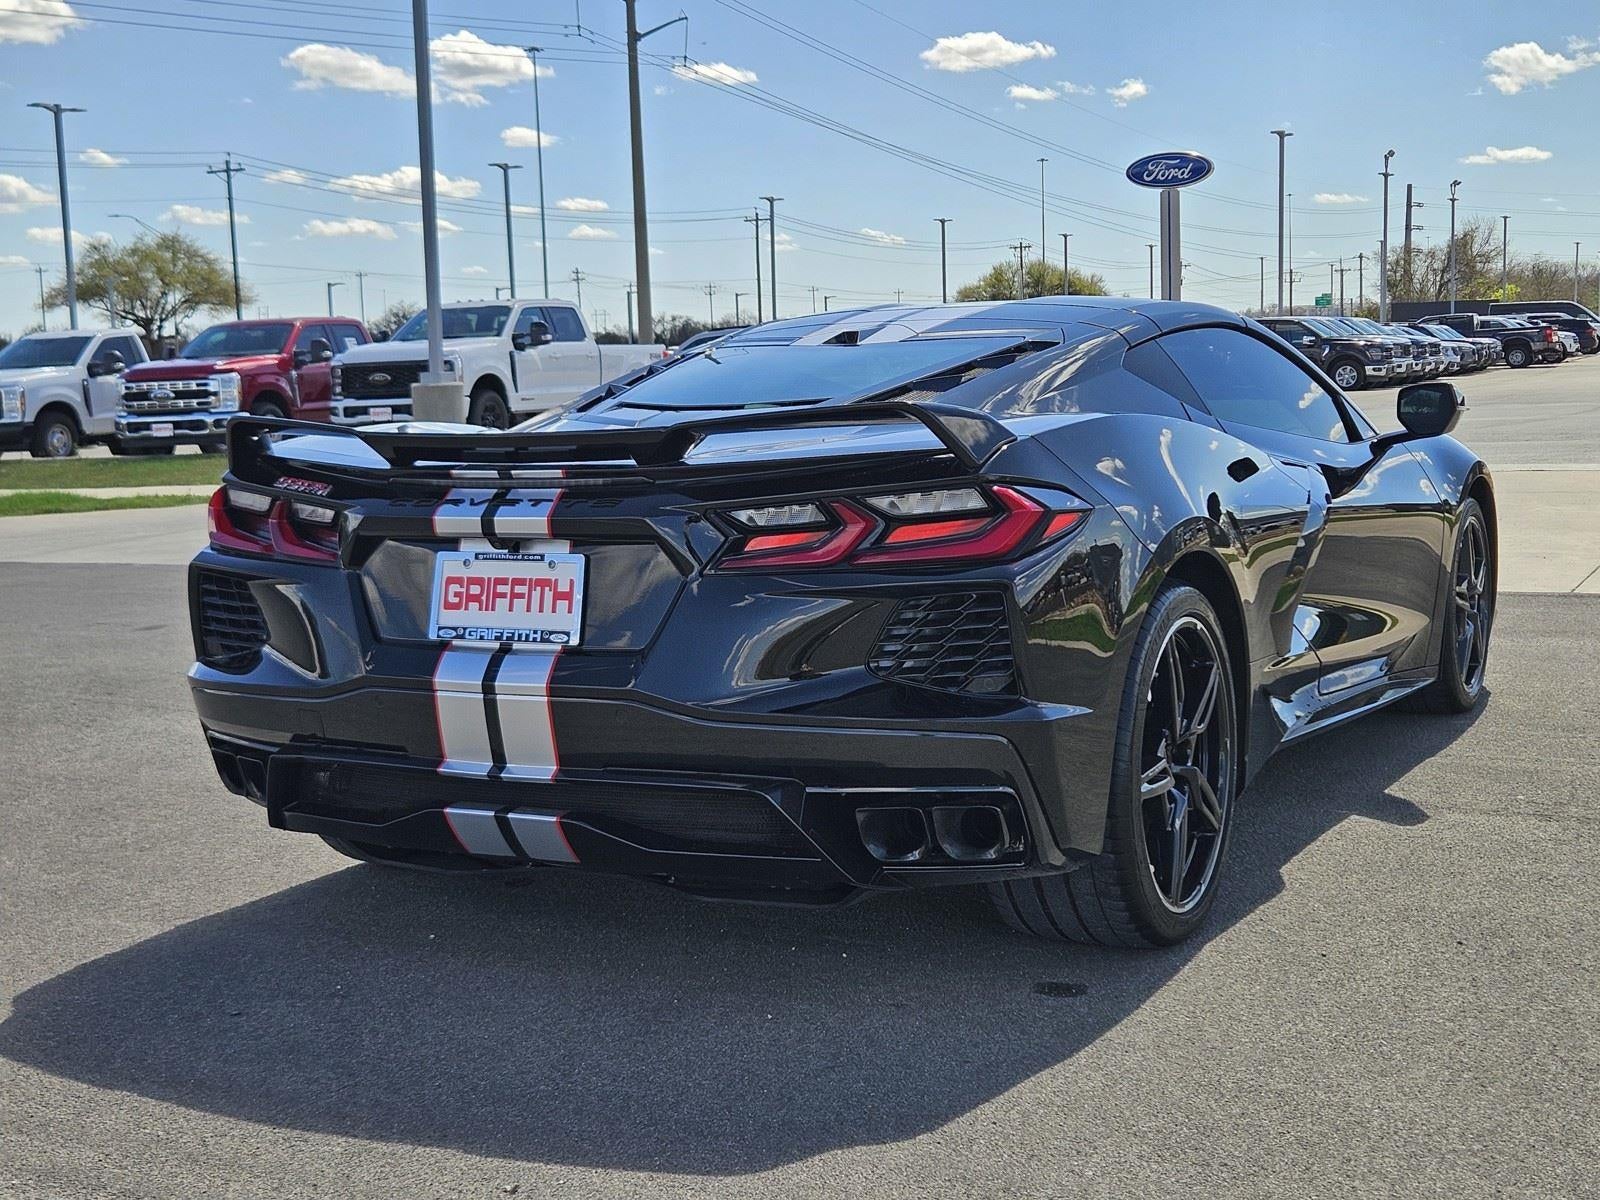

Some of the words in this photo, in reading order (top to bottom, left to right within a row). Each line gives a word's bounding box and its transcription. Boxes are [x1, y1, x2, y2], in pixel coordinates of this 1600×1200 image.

[1143, 158, 1193, 181] Ford
[388, 497, 624, 508] CORVETTE
[478, 553, 542, 561] griffithford.com
[443, 575, 575, 614] GRIFFITH
[464, 627, 542, 642] GRIFFITH
